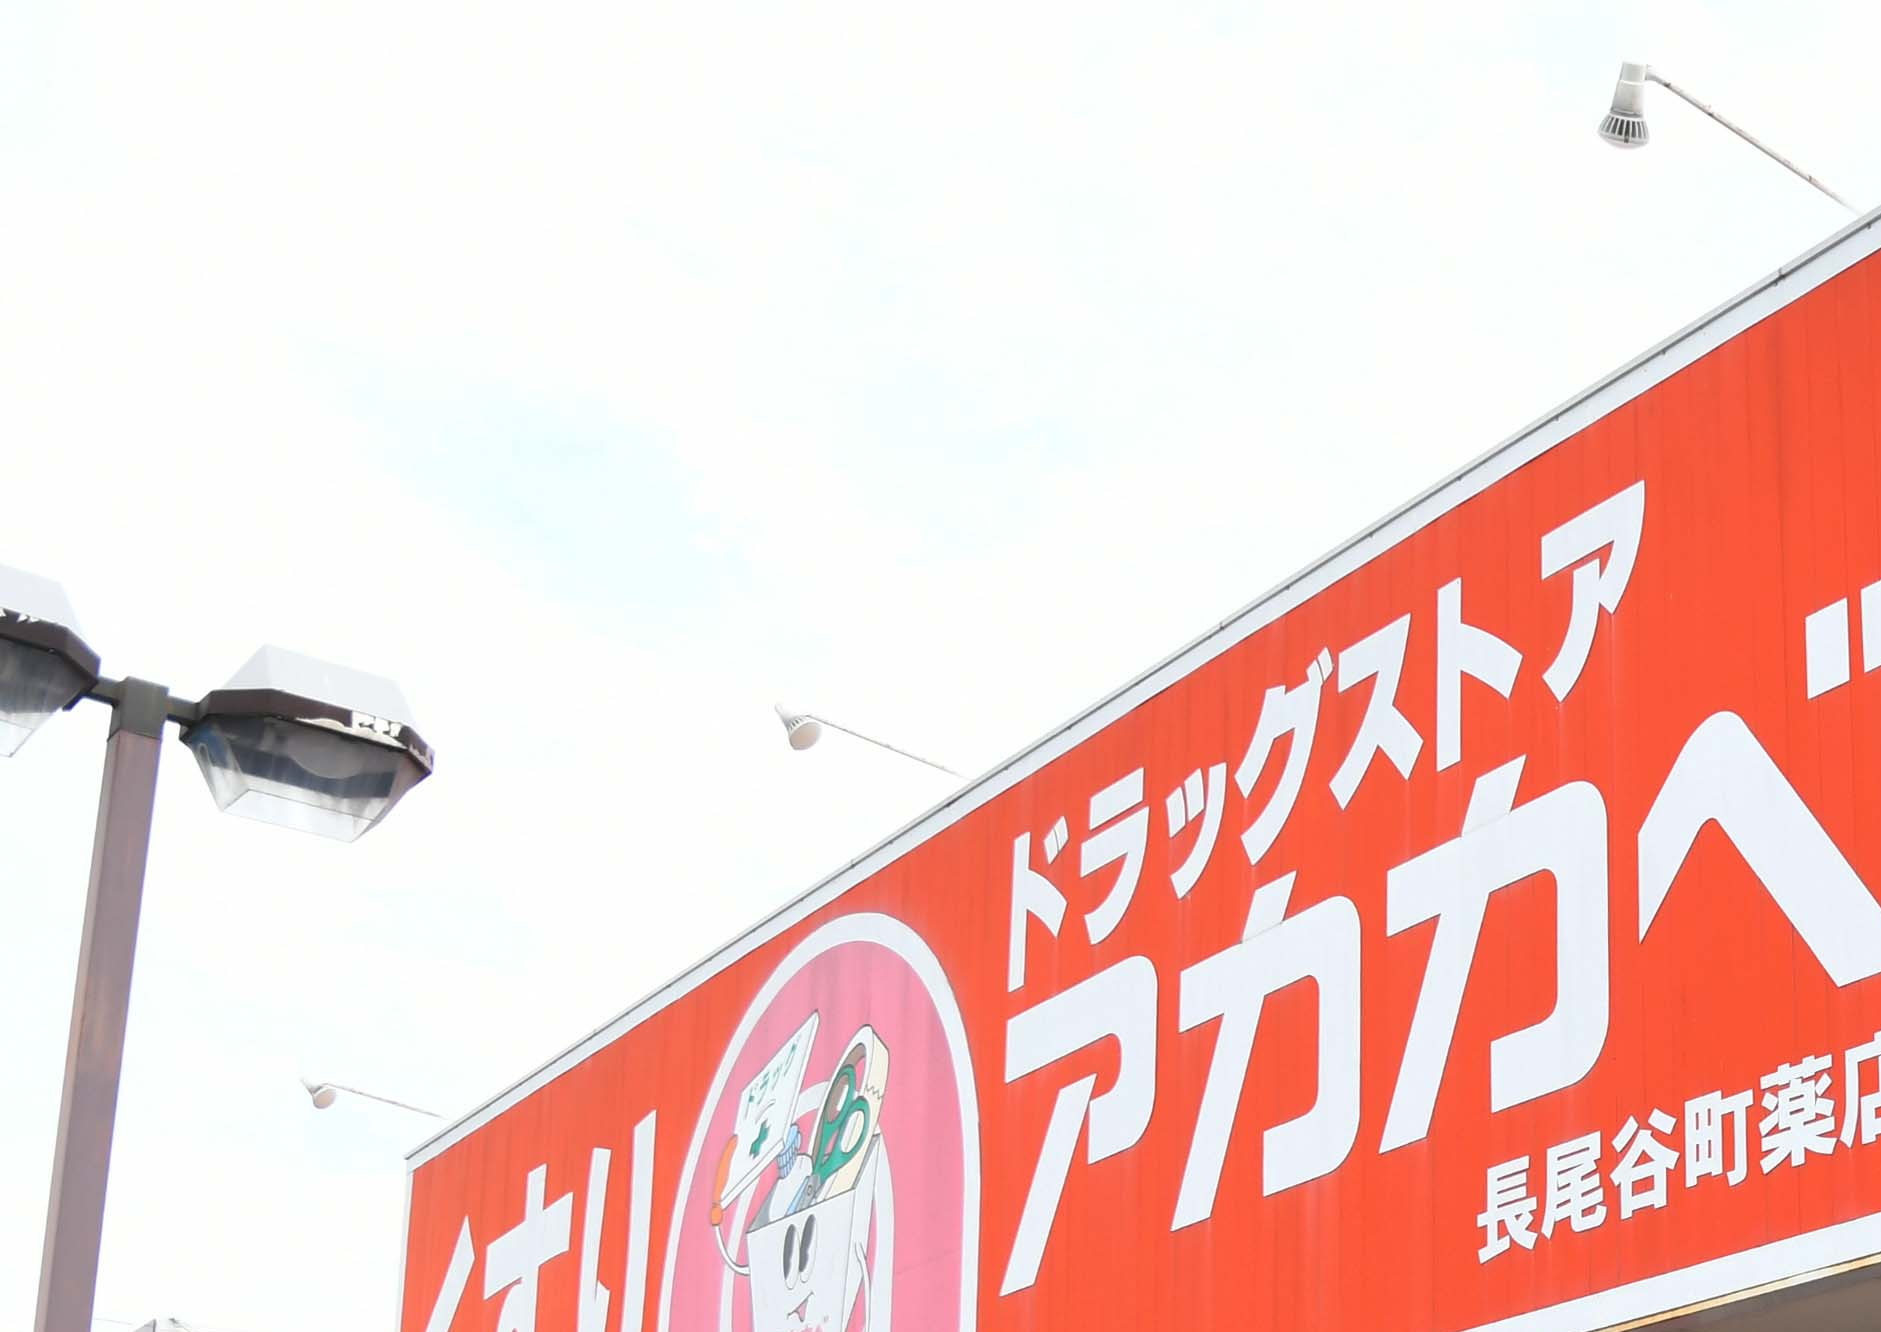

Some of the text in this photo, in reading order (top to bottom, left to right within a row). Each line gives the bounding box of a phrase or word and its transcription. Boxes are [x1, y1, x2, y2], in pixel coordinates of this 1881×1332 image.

[1008, 480, 1646, 992] ドラッグストア
